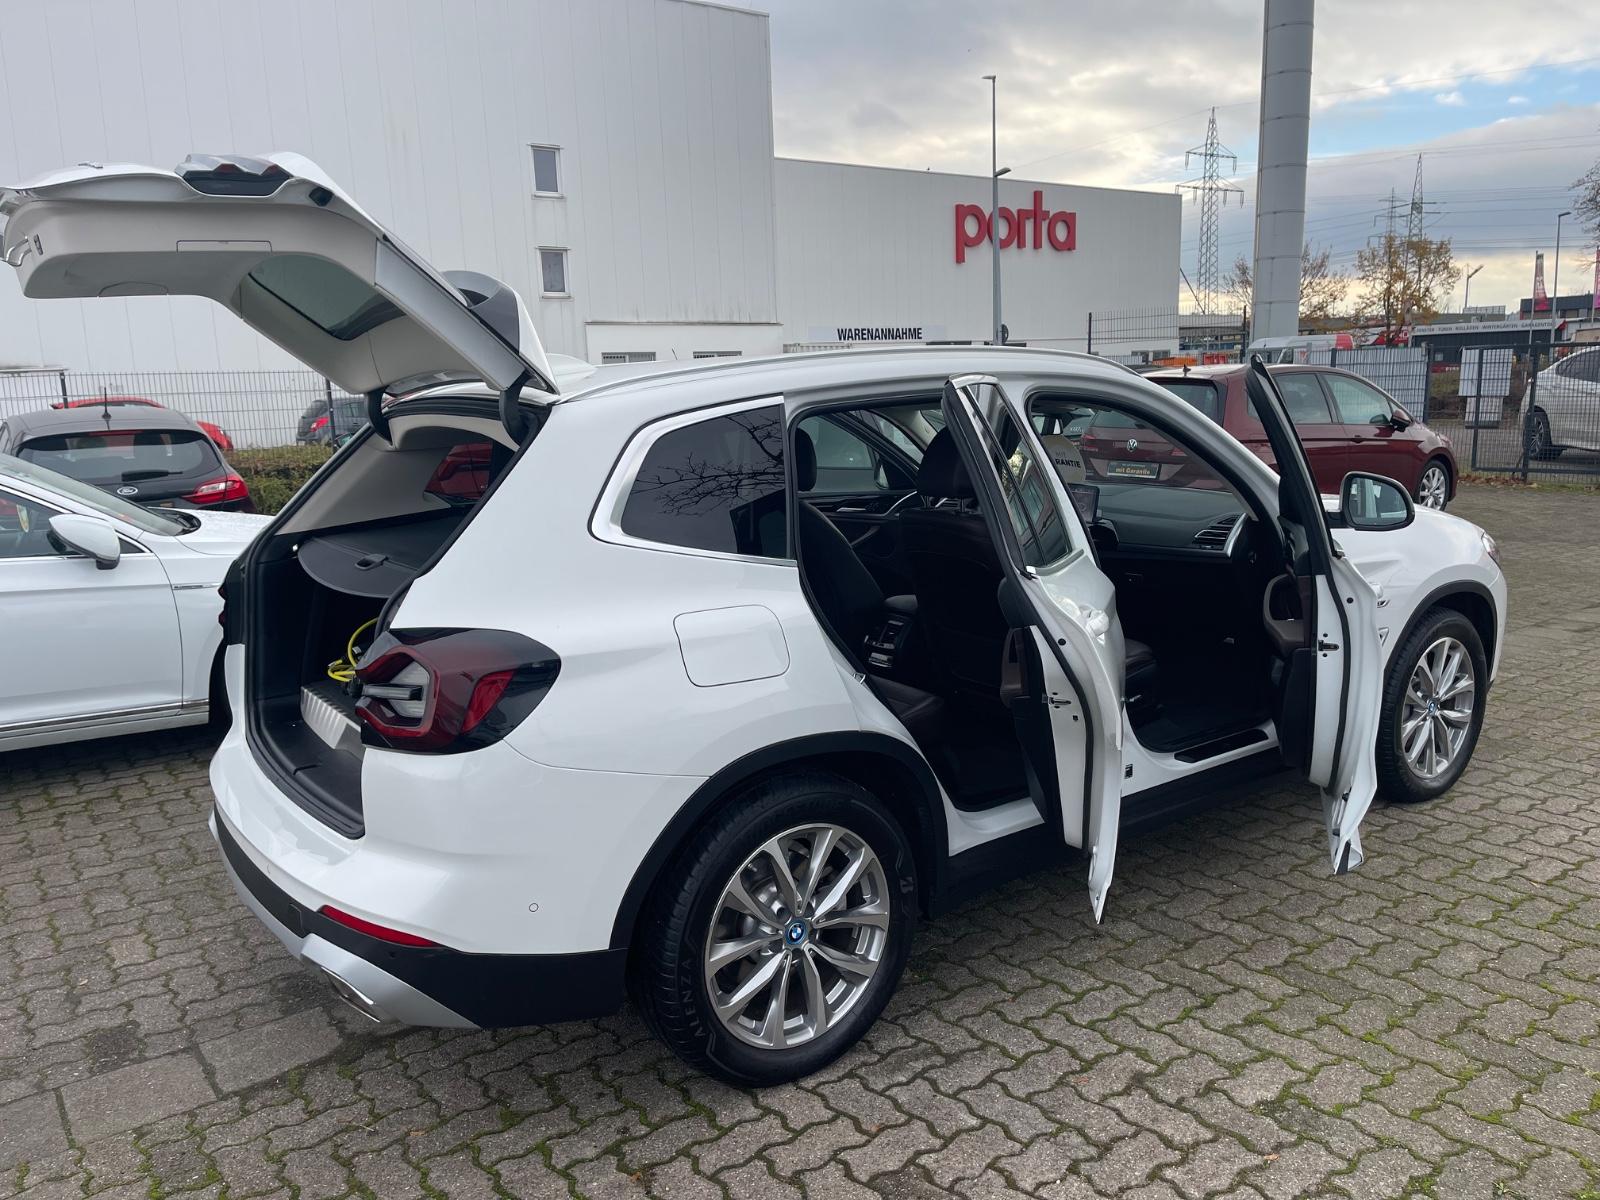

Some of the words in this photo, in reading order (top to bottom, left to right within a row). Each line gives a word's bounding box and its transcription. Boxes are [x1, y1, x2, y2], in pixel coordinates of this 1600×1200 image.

[955, 190, 1076, 264] porta
[837, 327, 923, 341] WARENANNAHME
[1055, 458, 1081, 468] RANTIE
[1126, 467, 1150, 475] Garantie
[681, 960, 706, 1037] ALENZA
